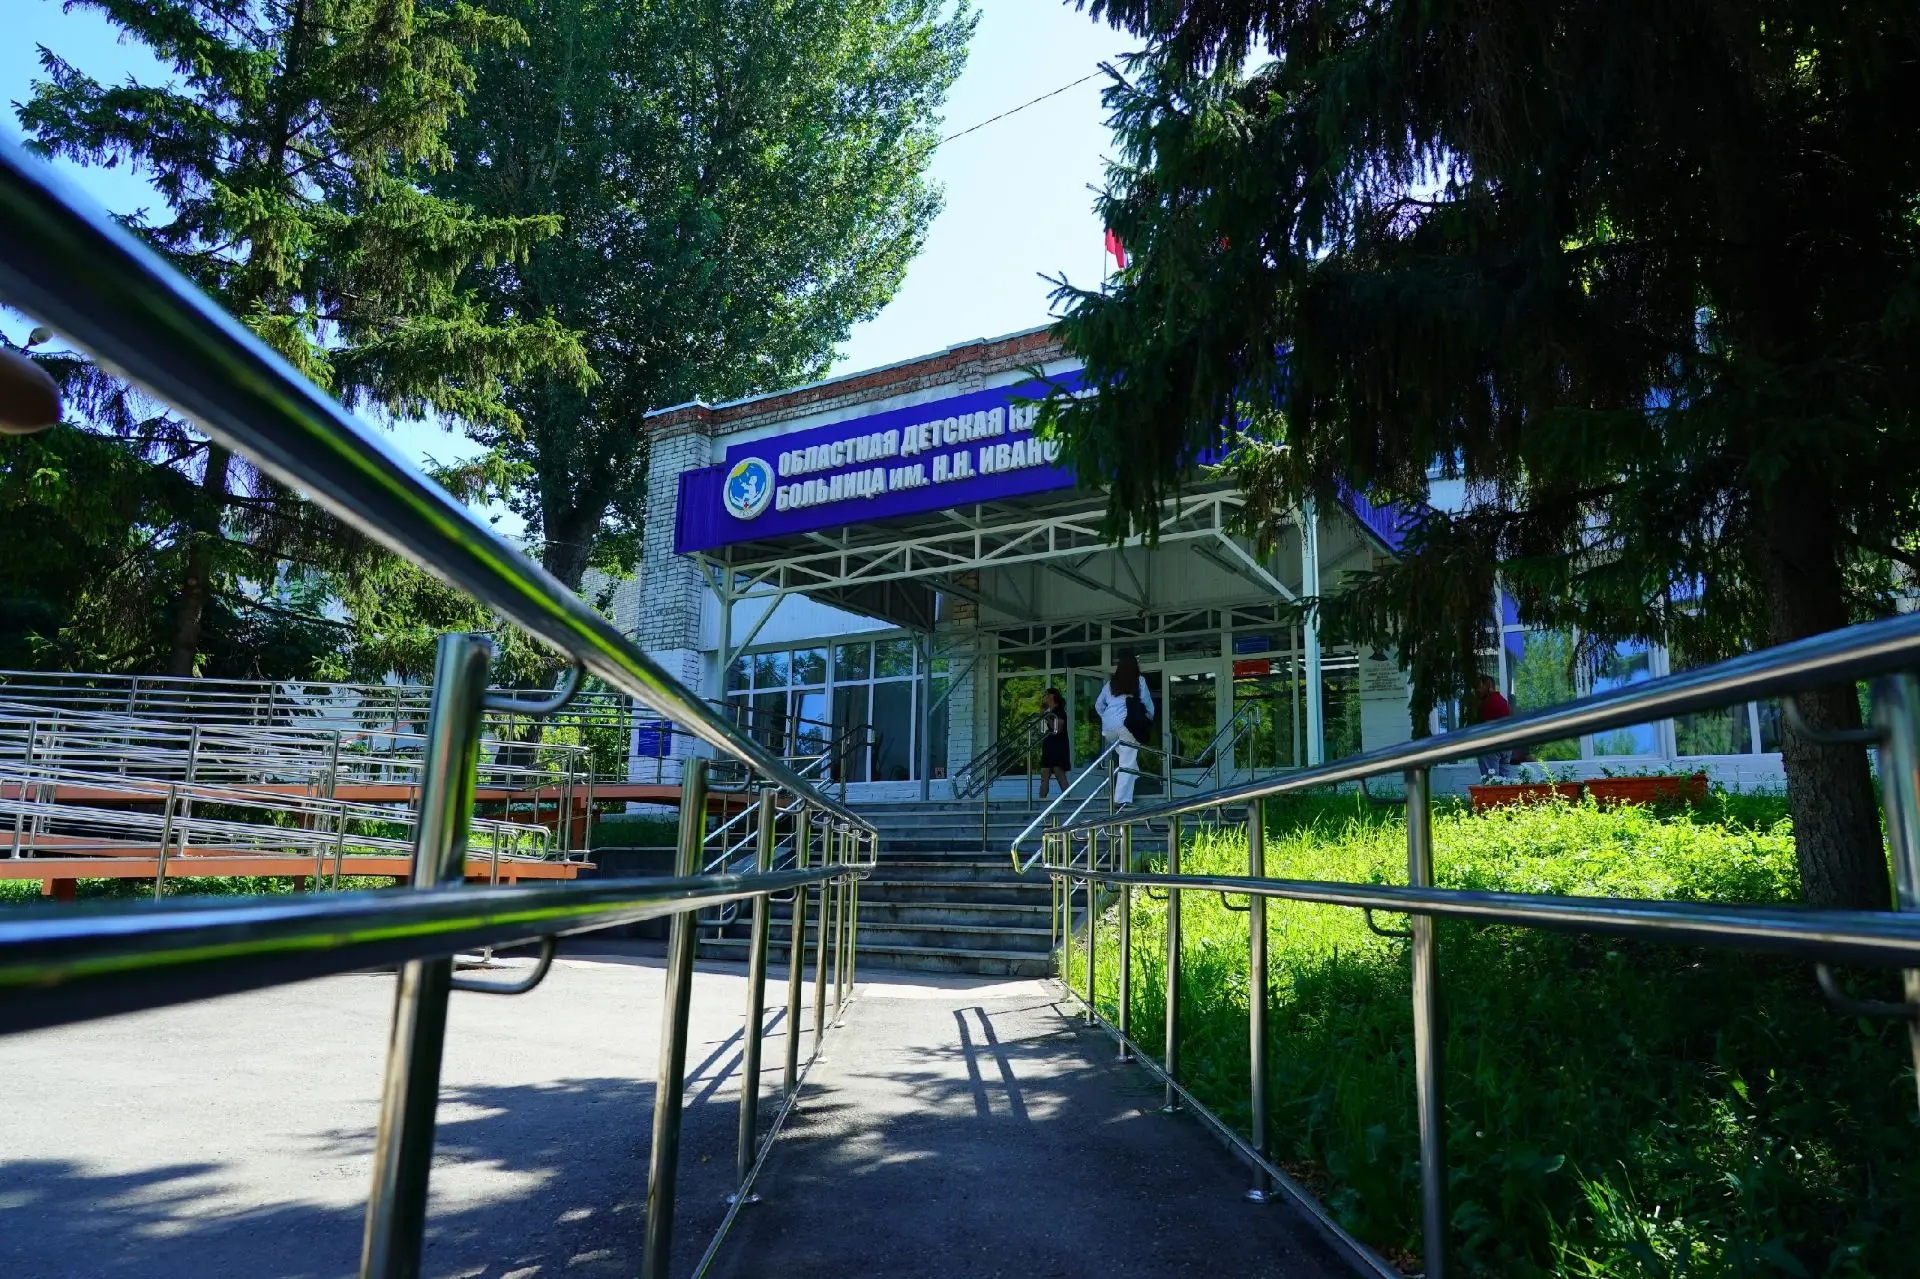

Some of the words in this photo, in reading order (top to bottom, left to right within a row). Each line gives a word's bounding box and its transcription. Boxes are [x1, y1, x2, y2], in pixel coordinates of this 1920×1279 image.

[775, 467, 889, 512] БОЛЬНИЦА
[932, 449, 977, 484] Н.Н.
[979, 433, 1064, 475] ИВАНО
[778, 429, 900, 477] ОБЛАСТНАЯ
[901, 406, 1006, 458] ДЕТСКАЯ
